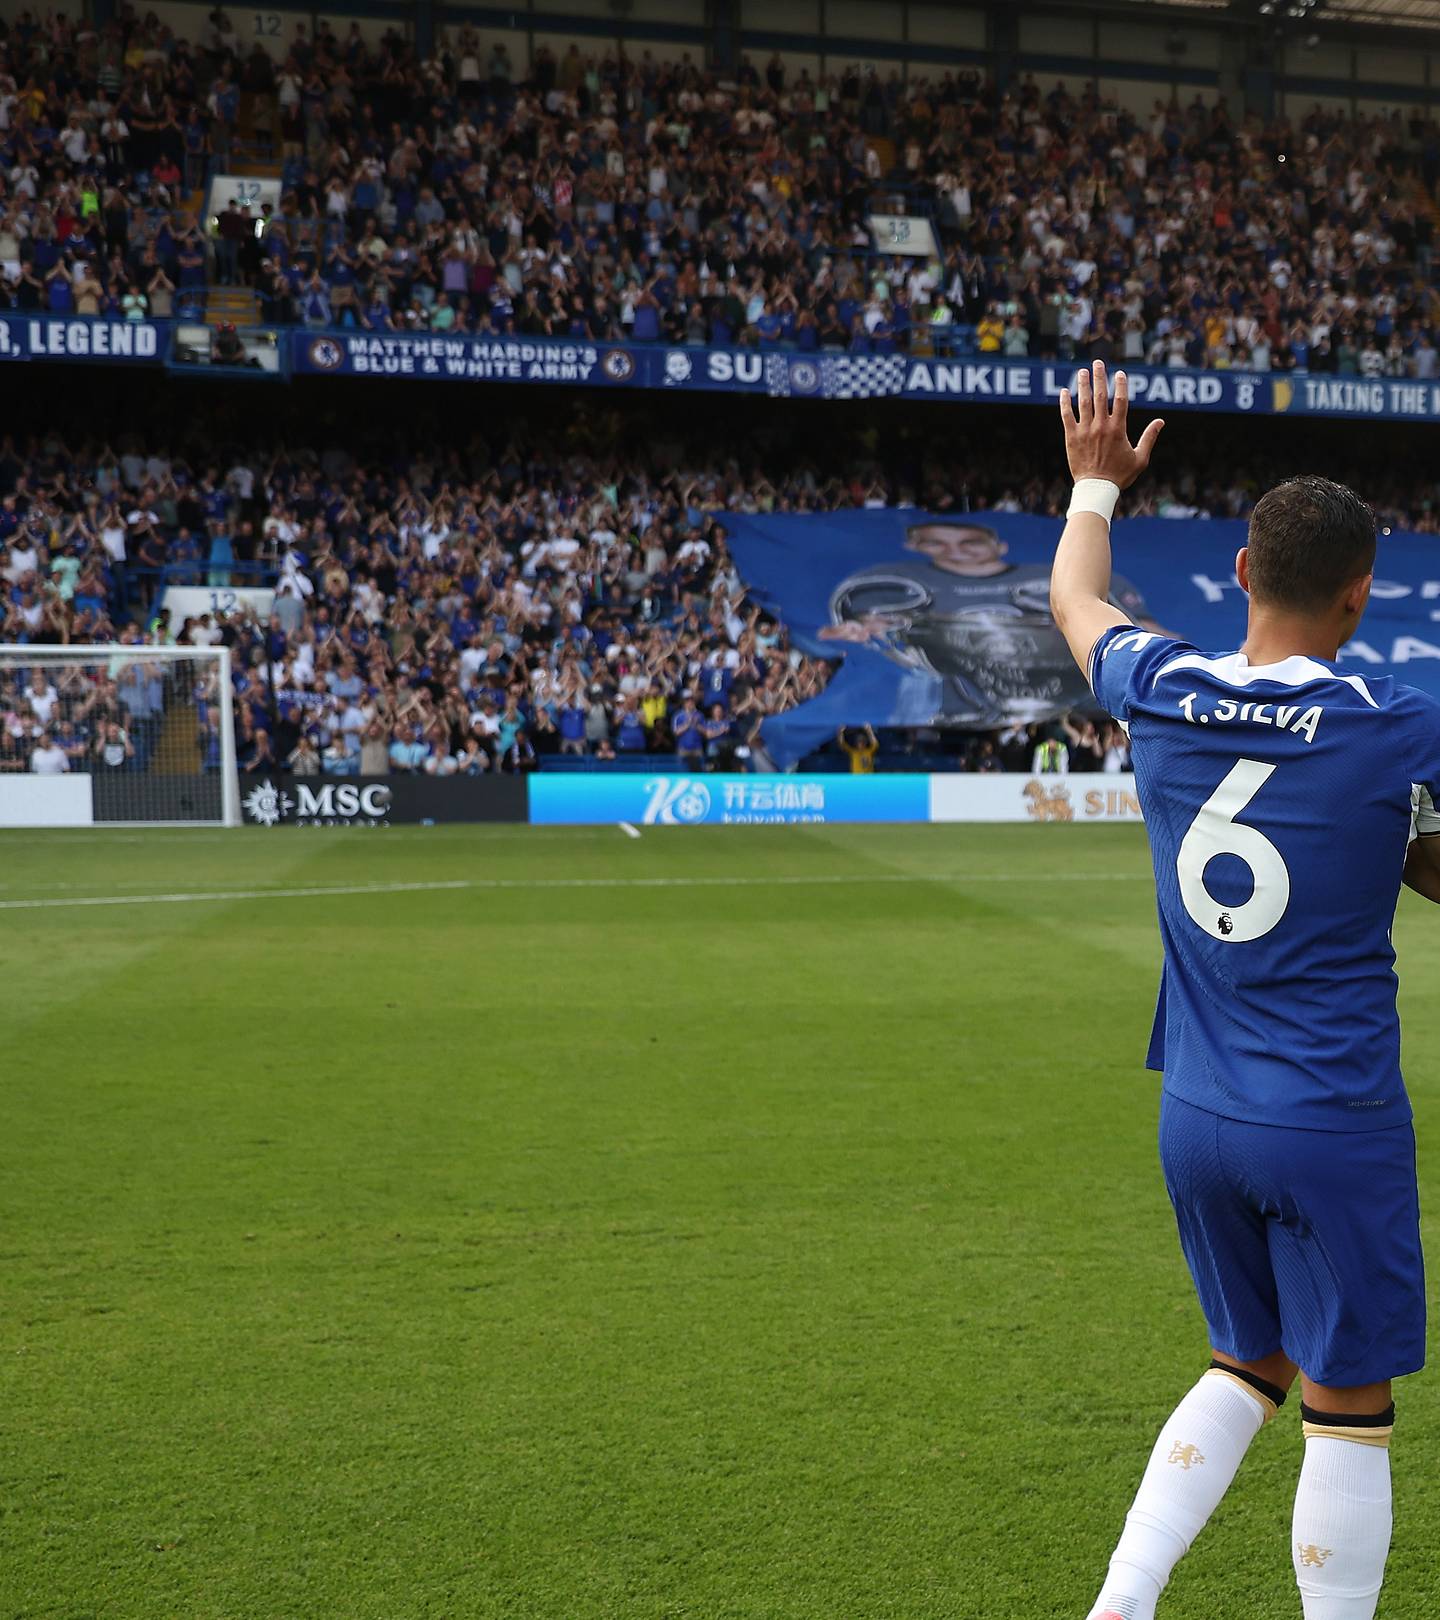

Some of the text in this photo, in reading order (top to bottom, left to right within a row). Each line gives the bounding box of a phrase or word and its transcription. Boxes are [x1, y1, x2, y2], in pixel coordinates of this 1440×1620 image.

[29, 321, 157, 357] LEGEND
[348, 336, 597, 365] MATTHEW HARDING'S
[353, 355, 592, 380] BLUE & WHITE ARMY
[907, 362, 1031, 396] ANKIE
[1044, 367, 1223, 404] LPARD
[1236, 383, 1256, 410] 8
[1305, 380, 1384, 413] TAKING
[1390, 383, 1428, 415] THE
[211, 590, 238, 613] 12
[295, 783, 391, 817] MSC
[723, 781, 826, 811] 开云体育
[1085, 790, 1141, 816] SIN
[1176, 757, 1291, 943] 6
